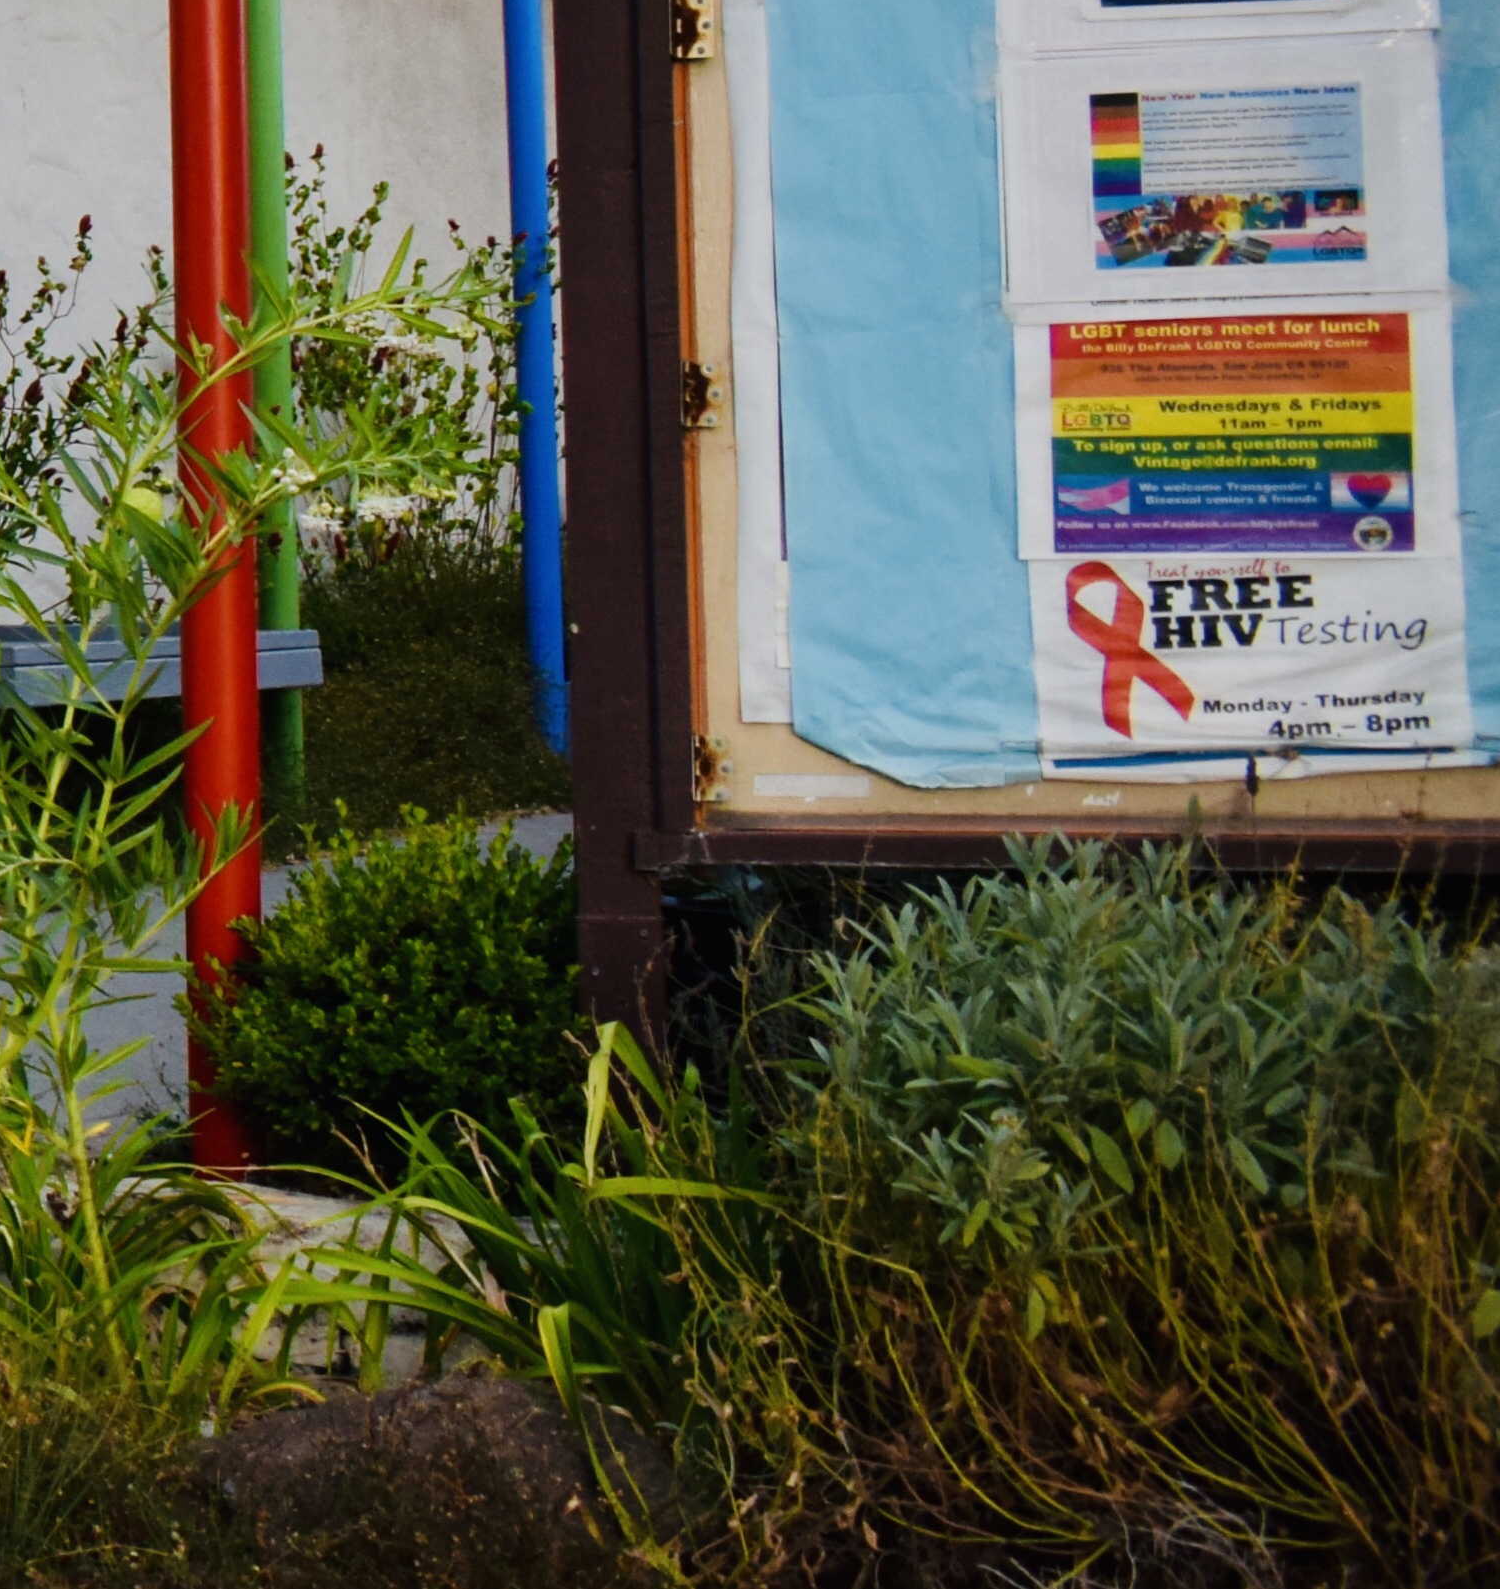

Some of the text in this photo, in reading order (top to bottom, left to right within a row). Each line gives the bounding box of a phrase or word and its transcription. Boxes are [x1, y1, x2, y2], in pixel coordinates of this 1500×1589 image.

[1070, 317, 1381, 340] LGBT seniors meet for lunch
[1081, 343, 1103, 354] the
[1106, 342, 1134, 355] Billy
[1137, 341, 1192, 353] DeFrank
[1246, 339, 1320, 351] Community
[1324, 338, 1369, 349] Center
[1158, 397, 1381, 414] Wednesdays & Fridays
[1062, 413, 1132, 428] LGBTQ
[1219, 417, 1266, 430] 11am
[1286, 417, 1323, 431] 1pm
[1073, 437, 1379, 455] To sign up, or ask questions email:
[1138, 482, 1160, 493] We
[1162, 481, 1222, 493] welcome
[1225, 481, 1309, 494] Transgender
[1144, 494, 1202, 506] Bisexual
[1204, 494, 1254, 505] seniors
[1271, 494, 1318, 505] friends
[1146, 559, 1291, 580] Treat yourself to
[1147, 575, 1315, 613] FREE
[1152, 609, 1428, 651] HIV Testing
[1203, 697, 1293, 714] Monday
[1315, 689, 1426, 709] Thursday
[1267, 718, 1332, 740] 4pm
[1365, 713, 1431, 735] 8pm
